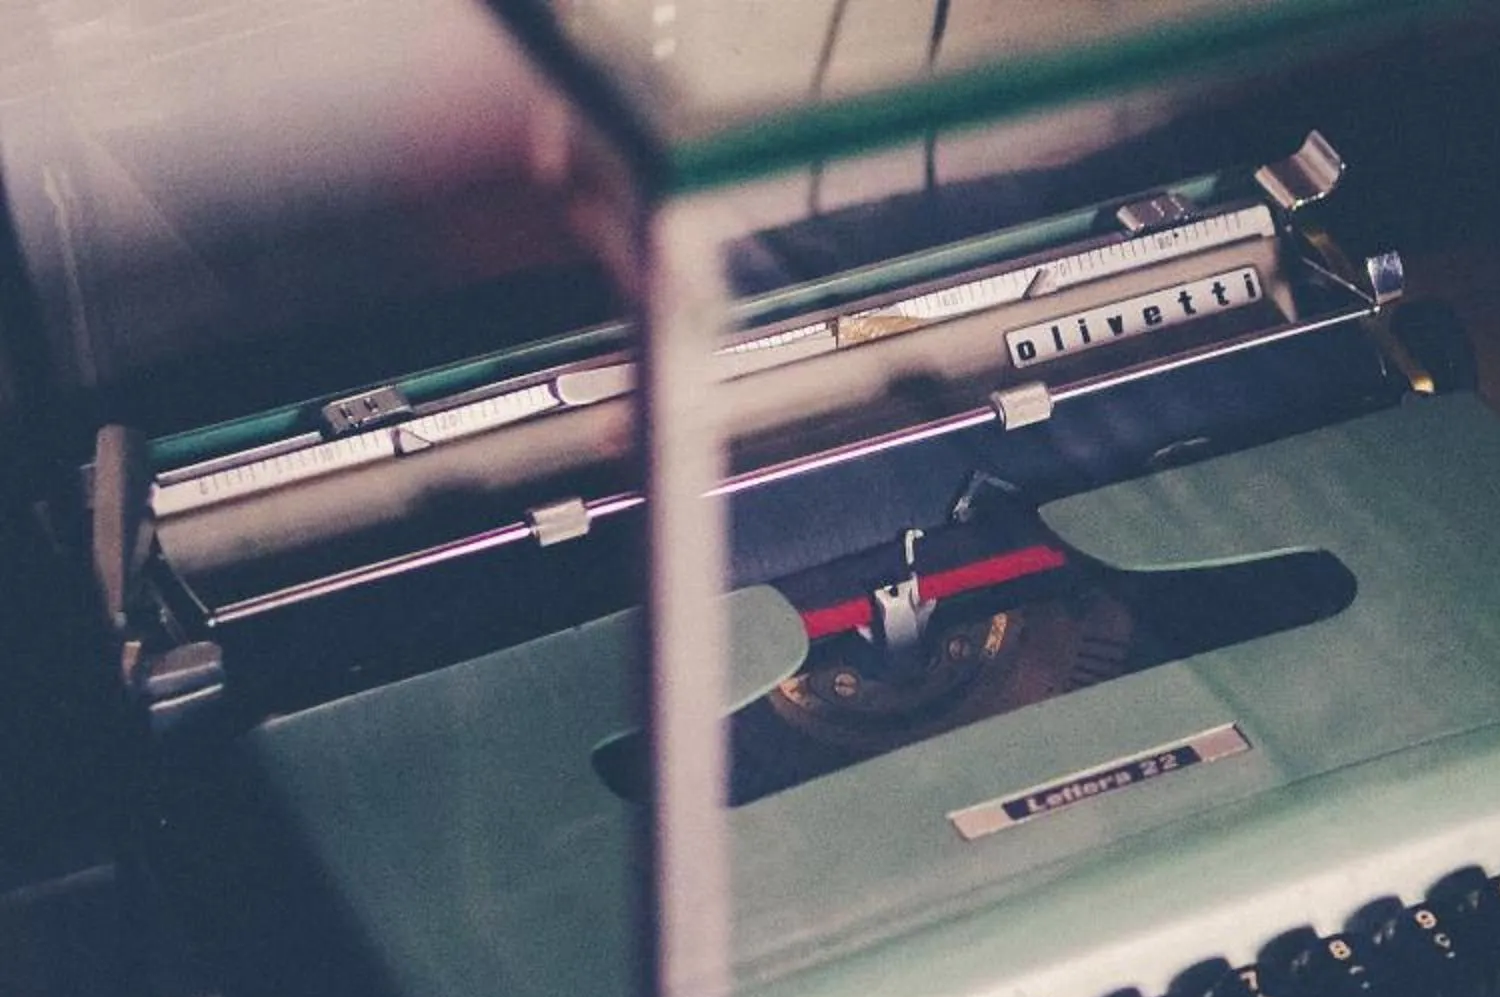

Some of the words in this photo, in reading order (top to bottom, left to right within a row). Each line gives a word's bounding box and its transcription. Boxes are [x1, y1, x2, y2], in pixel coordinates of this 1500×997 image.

[1015, 273, 1257, 361] olivetti
[1025, 772, 1131, 813] Lettera
[1139, 753, 1179, 778] 22
[1329, 940, 1351, 960] 8
[1415, 910, 1436, 929] 9
